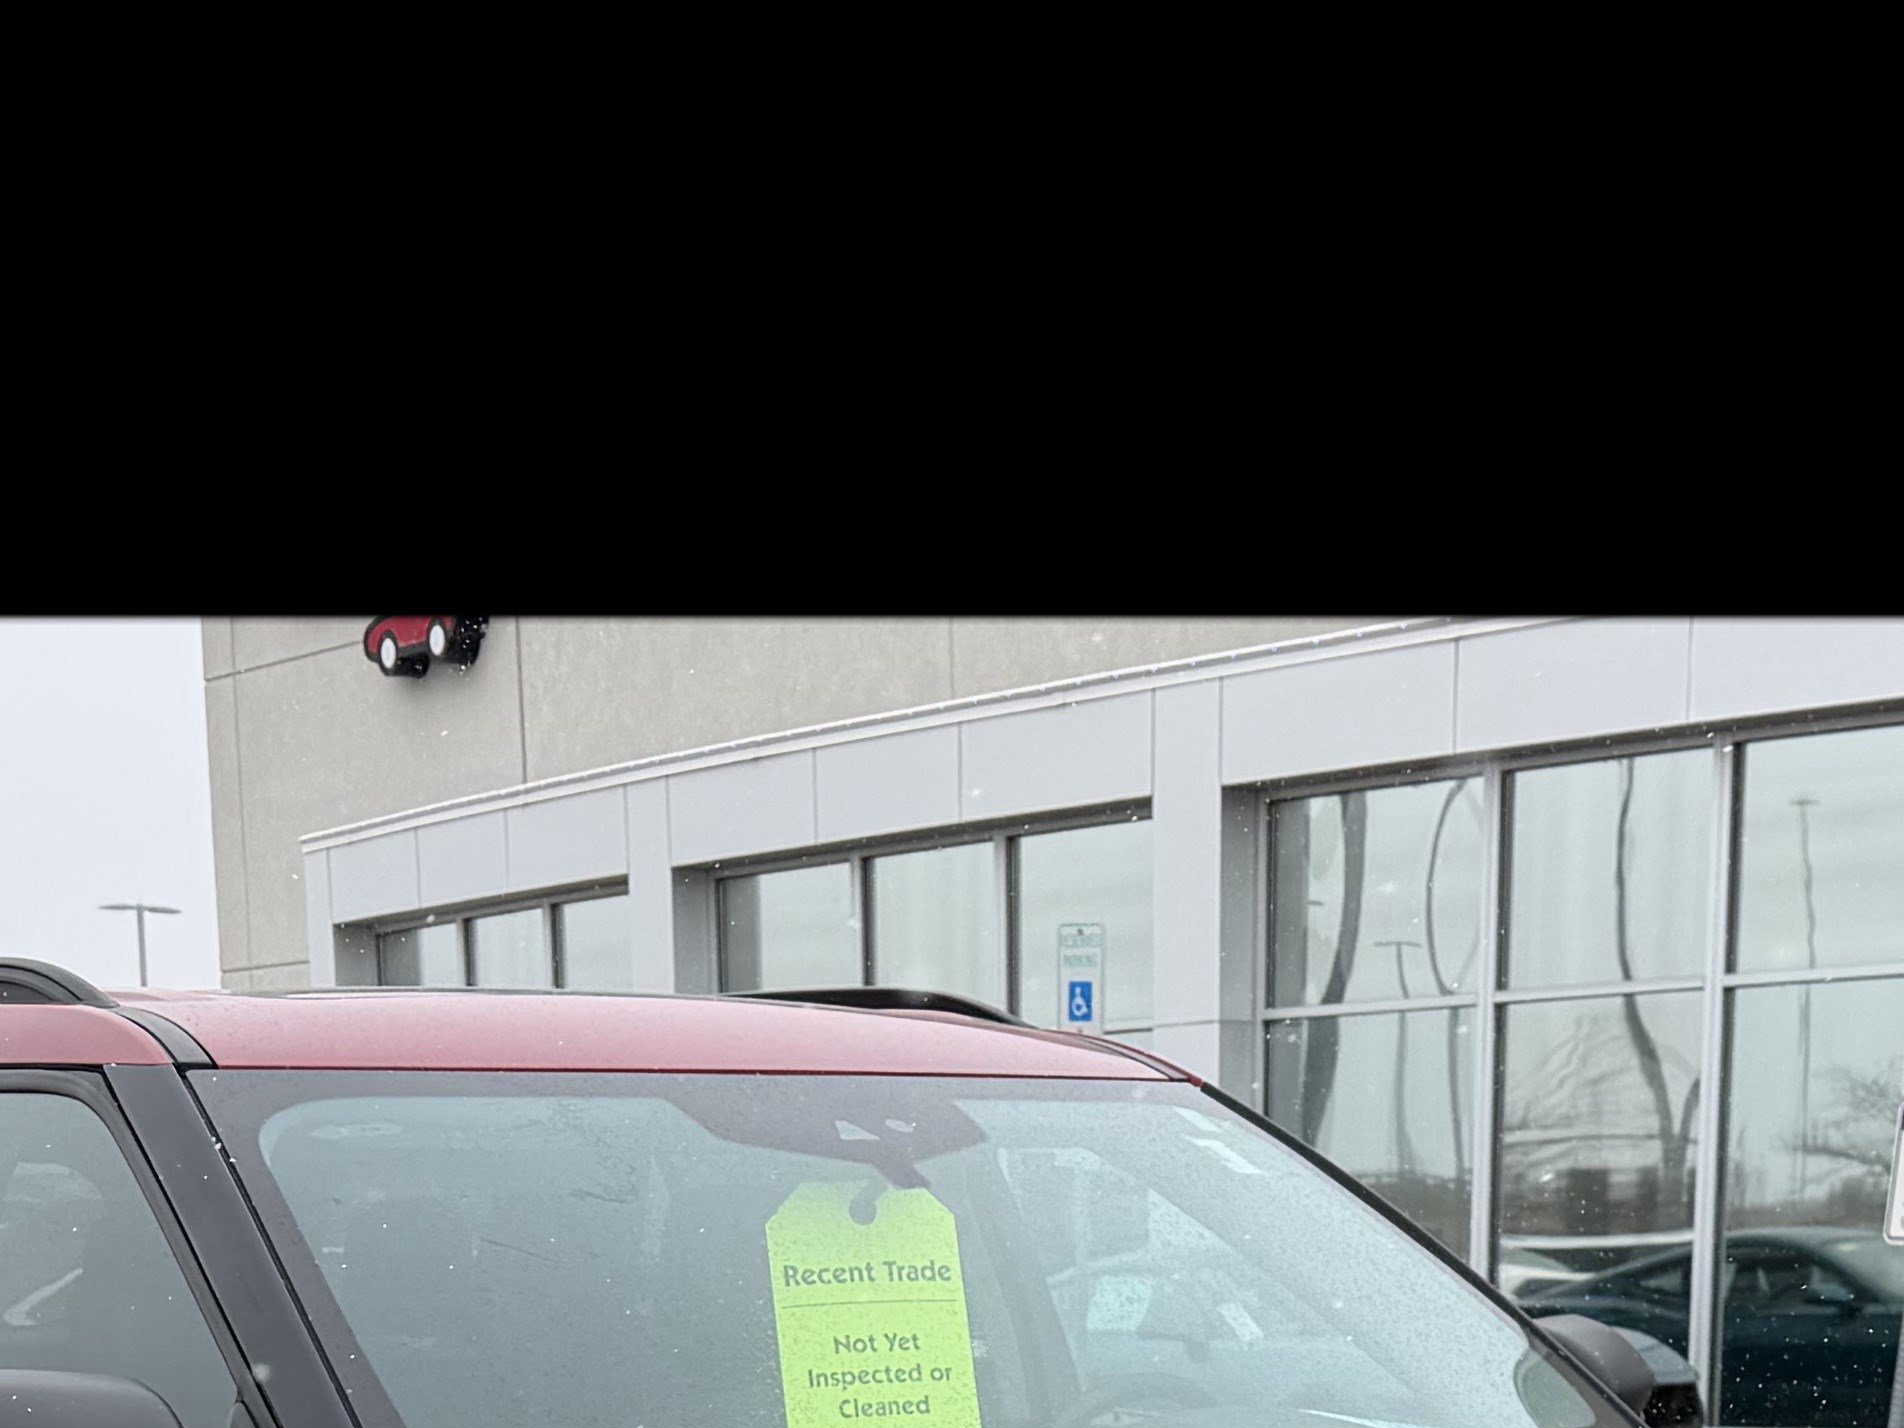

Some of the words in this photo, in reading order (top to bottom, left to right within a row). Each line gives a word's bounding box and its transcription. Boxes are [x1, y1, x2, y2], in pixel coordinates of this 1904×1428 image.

[783, 1261, 876, 1287] Recent
[882, 1259, 952, 1282] Trade
[833, 1334, 878, 1354] Not
[884, 1332, 921, 1352] Yet
[808, 1363, 923, 1391] Inspected
[930, 1367, 952, 1382] or
[839, 1395, 931, 1418] Cleaned
